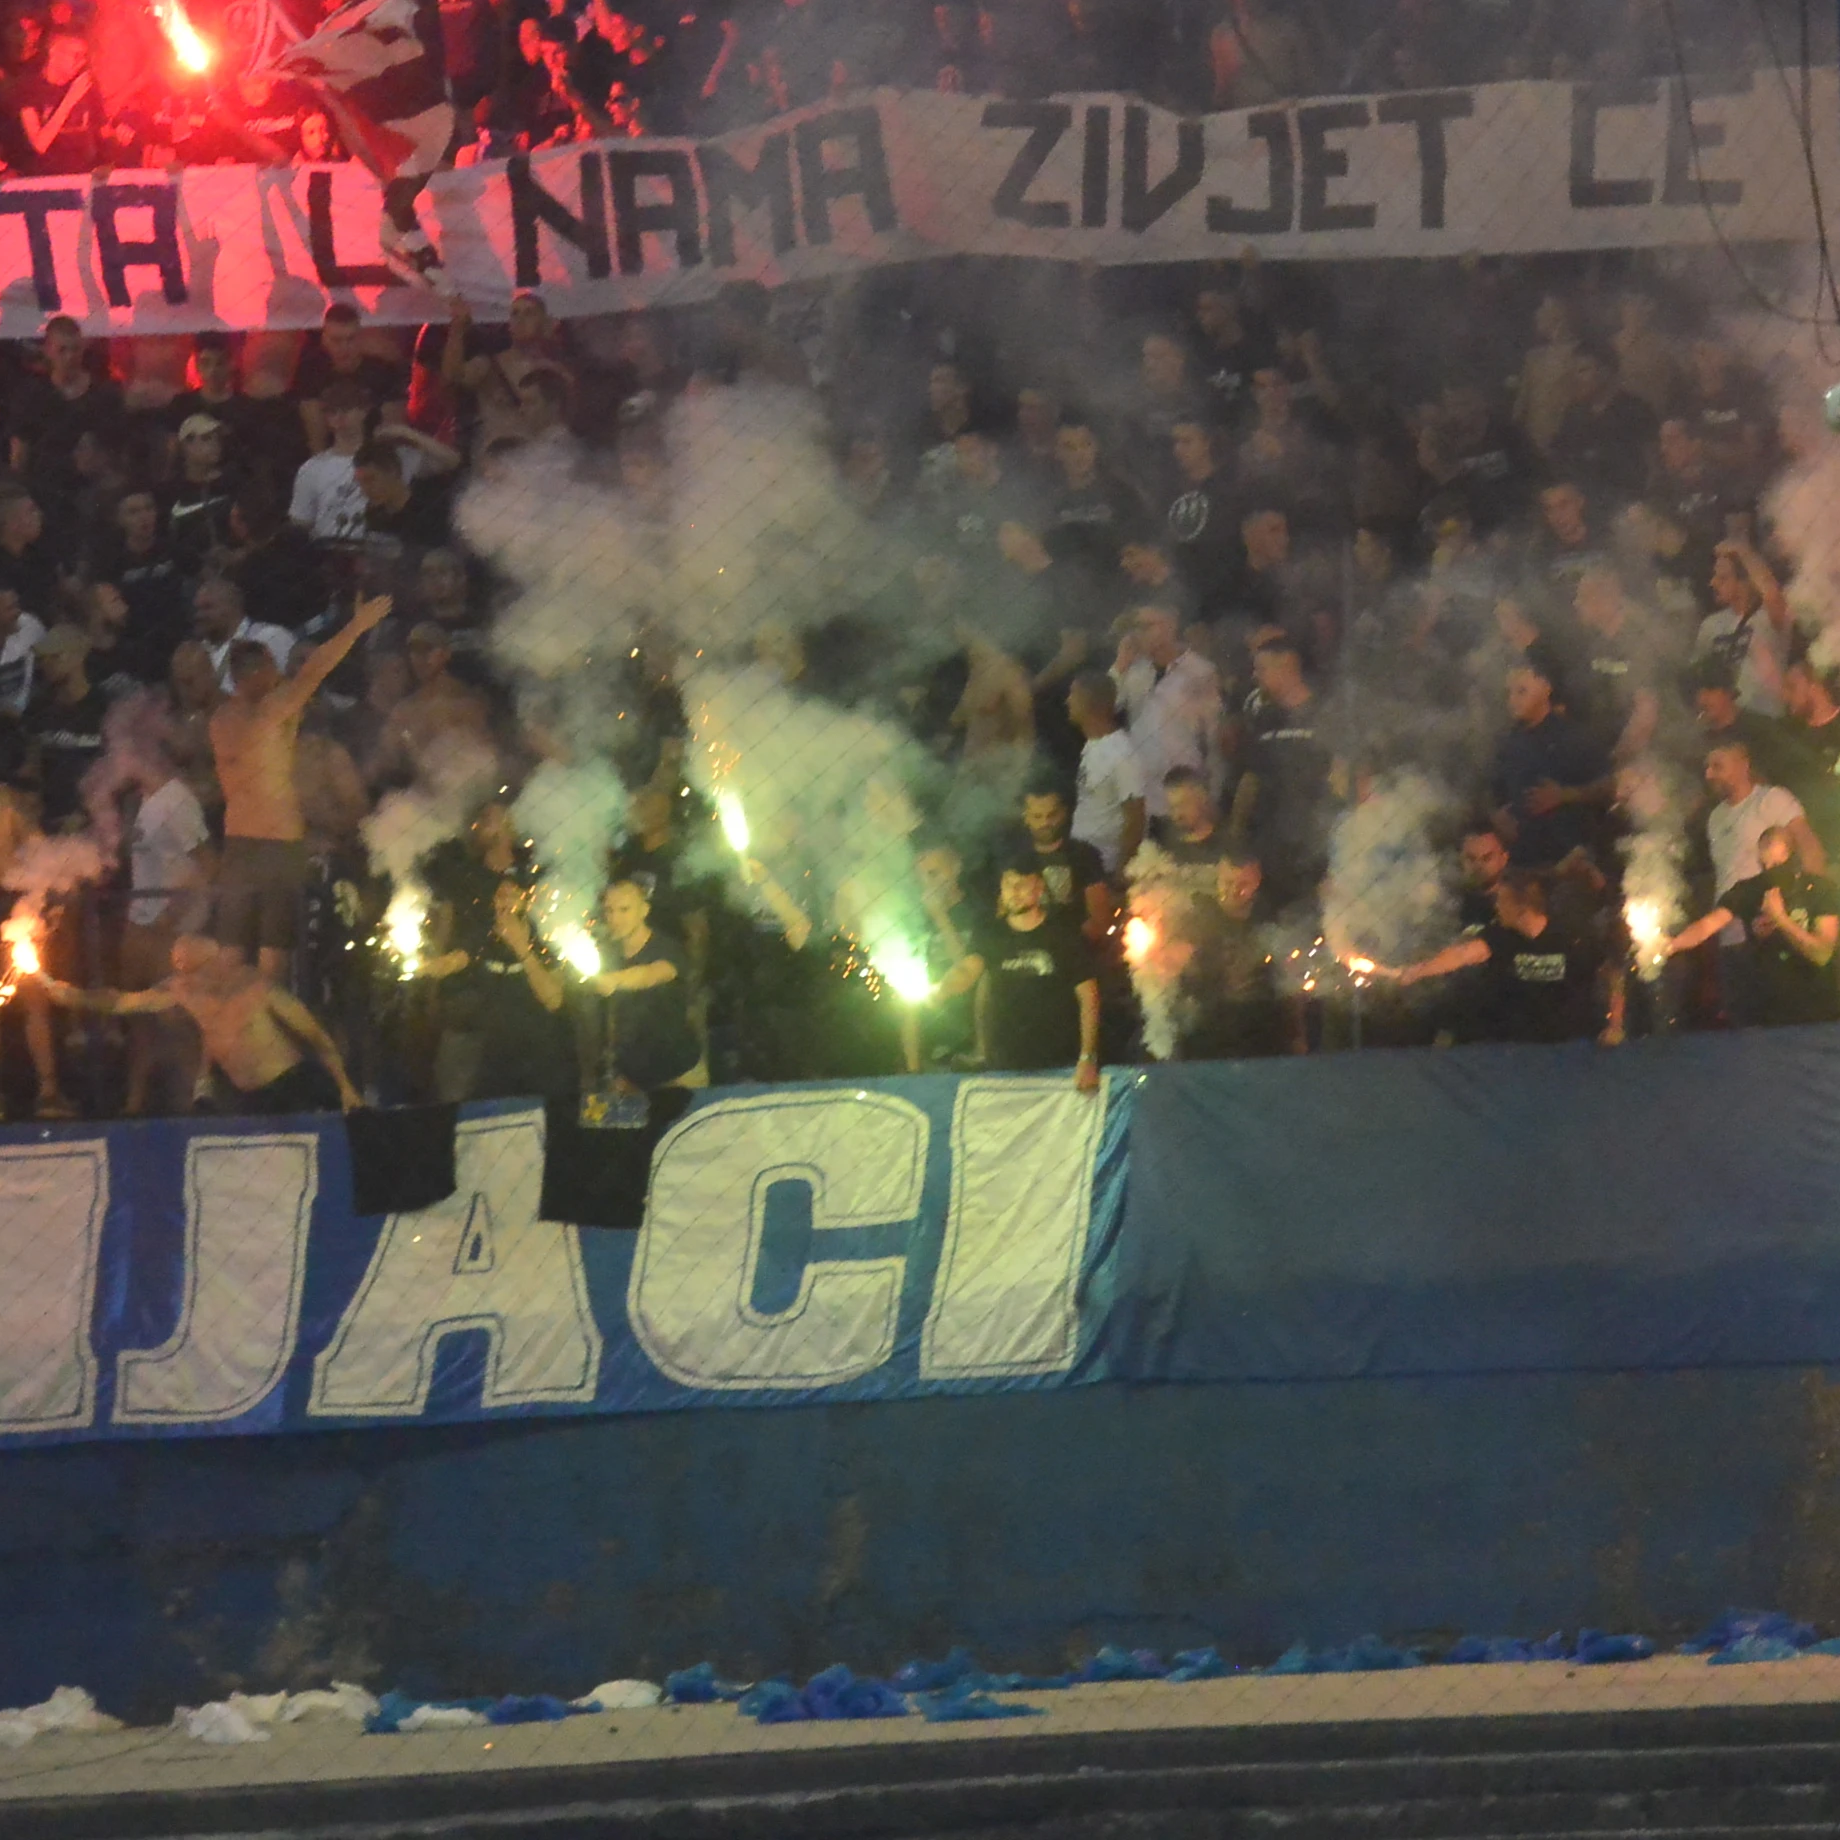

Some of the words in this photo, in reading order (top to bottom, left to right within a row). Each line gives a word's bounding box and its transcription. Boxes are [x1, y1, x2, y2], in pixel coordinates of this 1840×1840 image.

[507, 104, 897, 287] NAMA
[980, 92, 1474, 234] ZIVJET
[1569, 75, 1743, 208] CE
